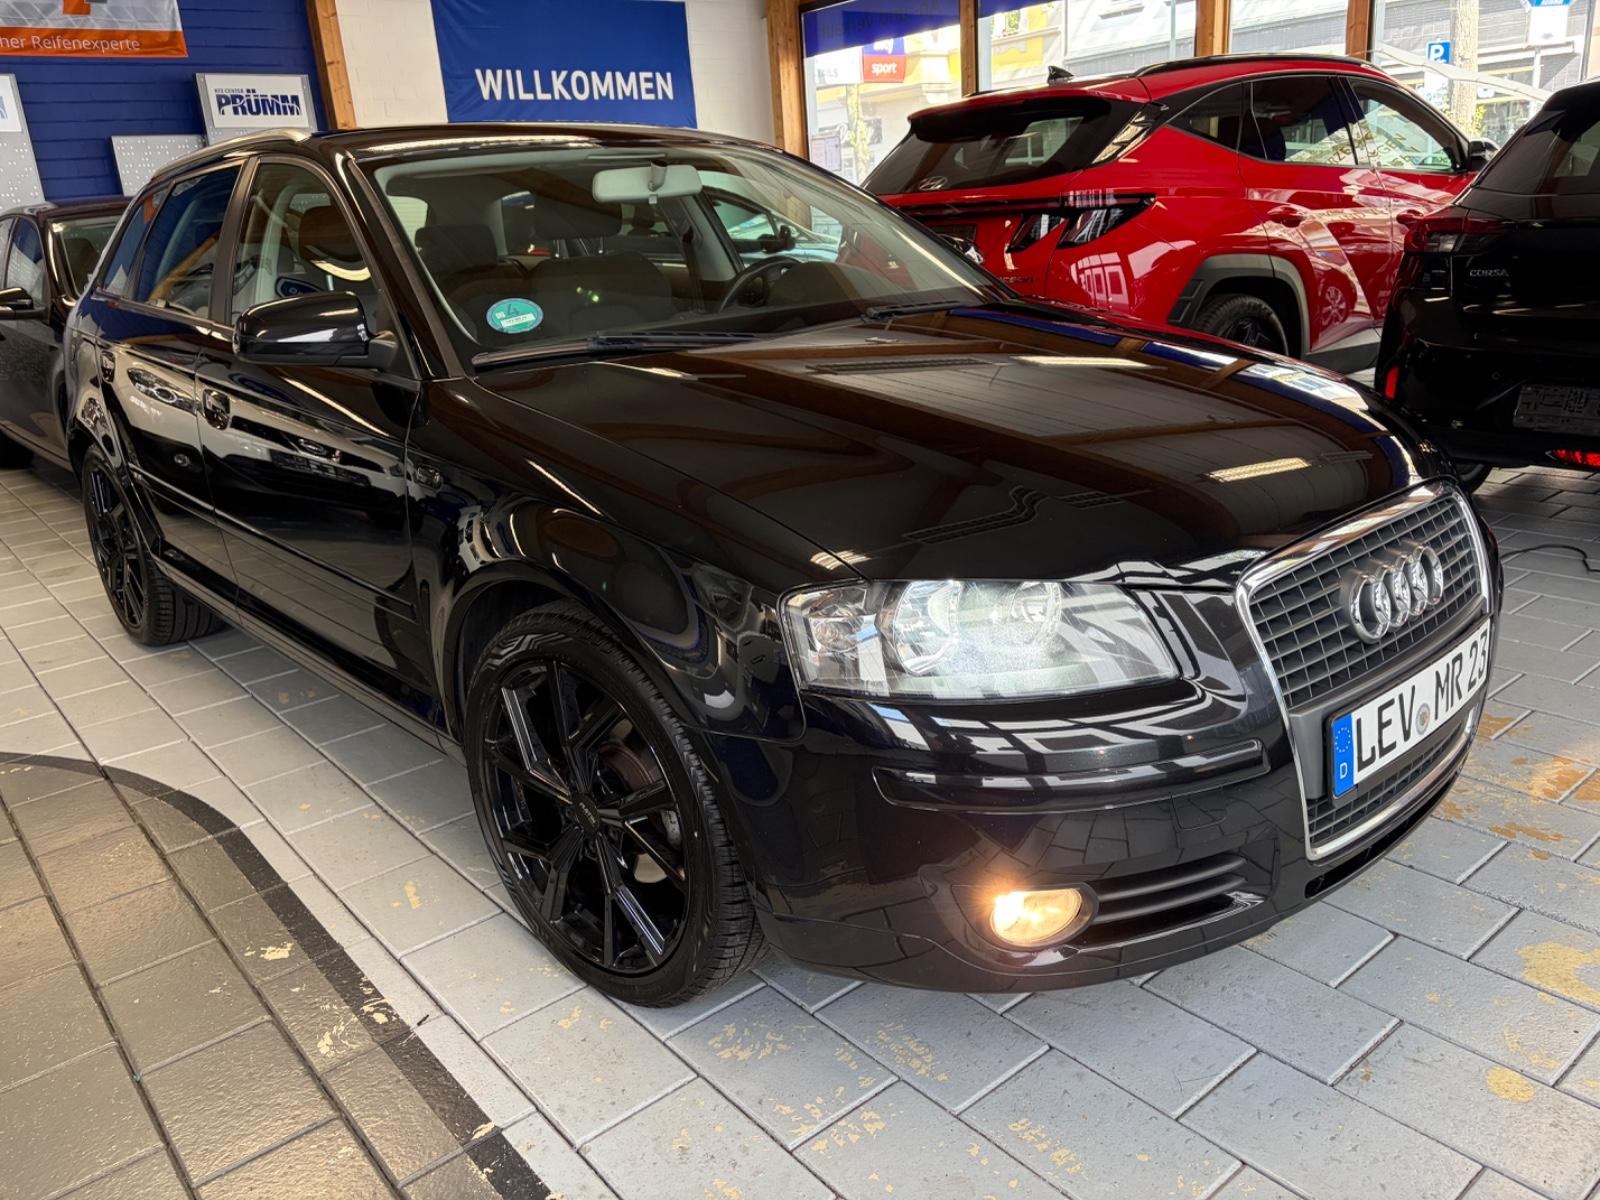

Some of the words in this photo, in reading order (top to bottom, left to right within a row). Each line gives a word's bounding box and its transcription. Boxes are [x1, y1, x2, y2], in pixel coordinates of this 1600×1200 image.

[31, 35, 140, 53] Reifenexperte
[1430, 44, 1445, 62] P
[871, 62, 897, 76] sport
[475, 69, 674, 101] WILLKOMMEN
[216, 88, 301, 116] PRÜMM
[1469, 268, 1510, 278] CORSA
[1356, 684, 1416, 773] LEV
[1434, 652, 1464, 721] MR
[1466, 629, 1488, 692] 23
[1339, 762, 1348, 779] D
